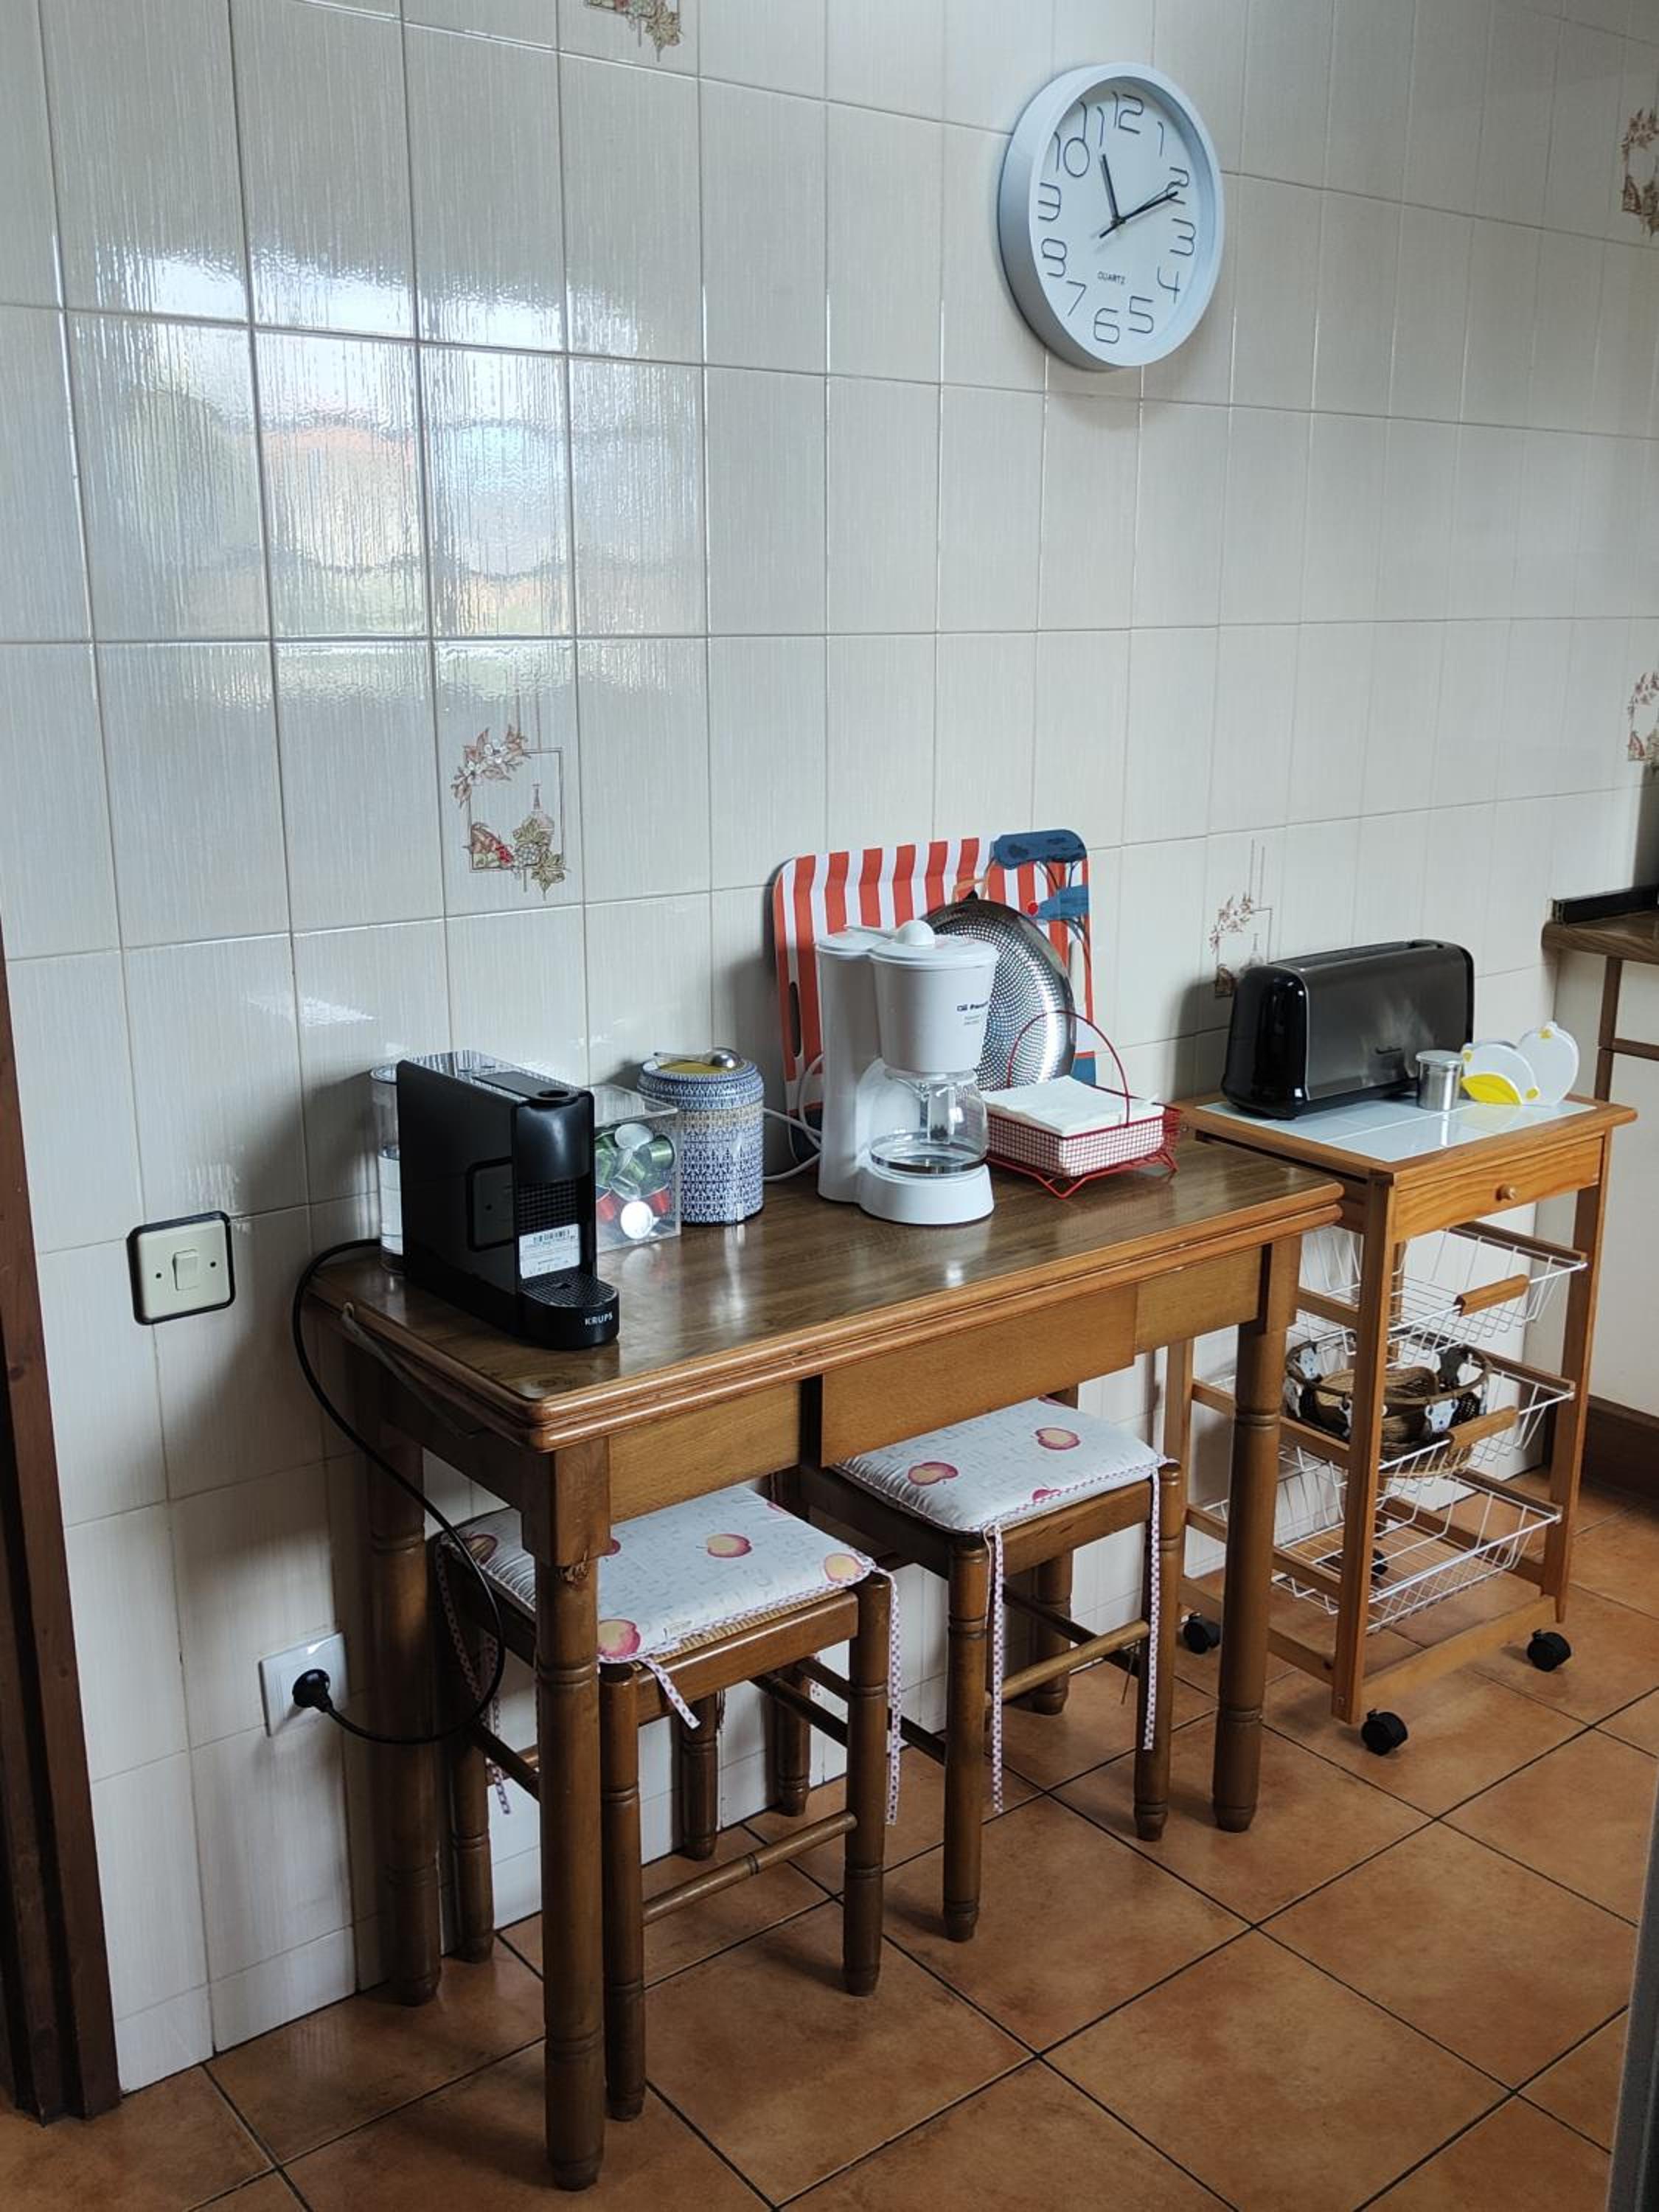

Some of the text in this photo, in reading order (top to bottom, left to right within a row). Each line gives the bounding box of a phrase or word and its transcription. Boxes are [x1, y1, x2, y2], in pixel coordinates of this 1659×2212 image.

[1111, 91, 1144, 134] 12
[1053, 131, 1091, 178] 10
[1157, 120, 1164, 157] 1
[1038, 181, 1062, 222] 9
[1169, 166, 1189, 205] 2
[1169, 218, 1196, 256] 3
[1040, 237, 1067, 277] 8
[1096, 271, 1127, 285] QUARTZ
[1157, 265, 1180, 305] 4
[1066, 279, 1086, 317] 7
[1127, 295, 1154, 334] 5
[1093, 307, 1120, 344] 6
[585, 1312, 613, 1325] KRUPS
